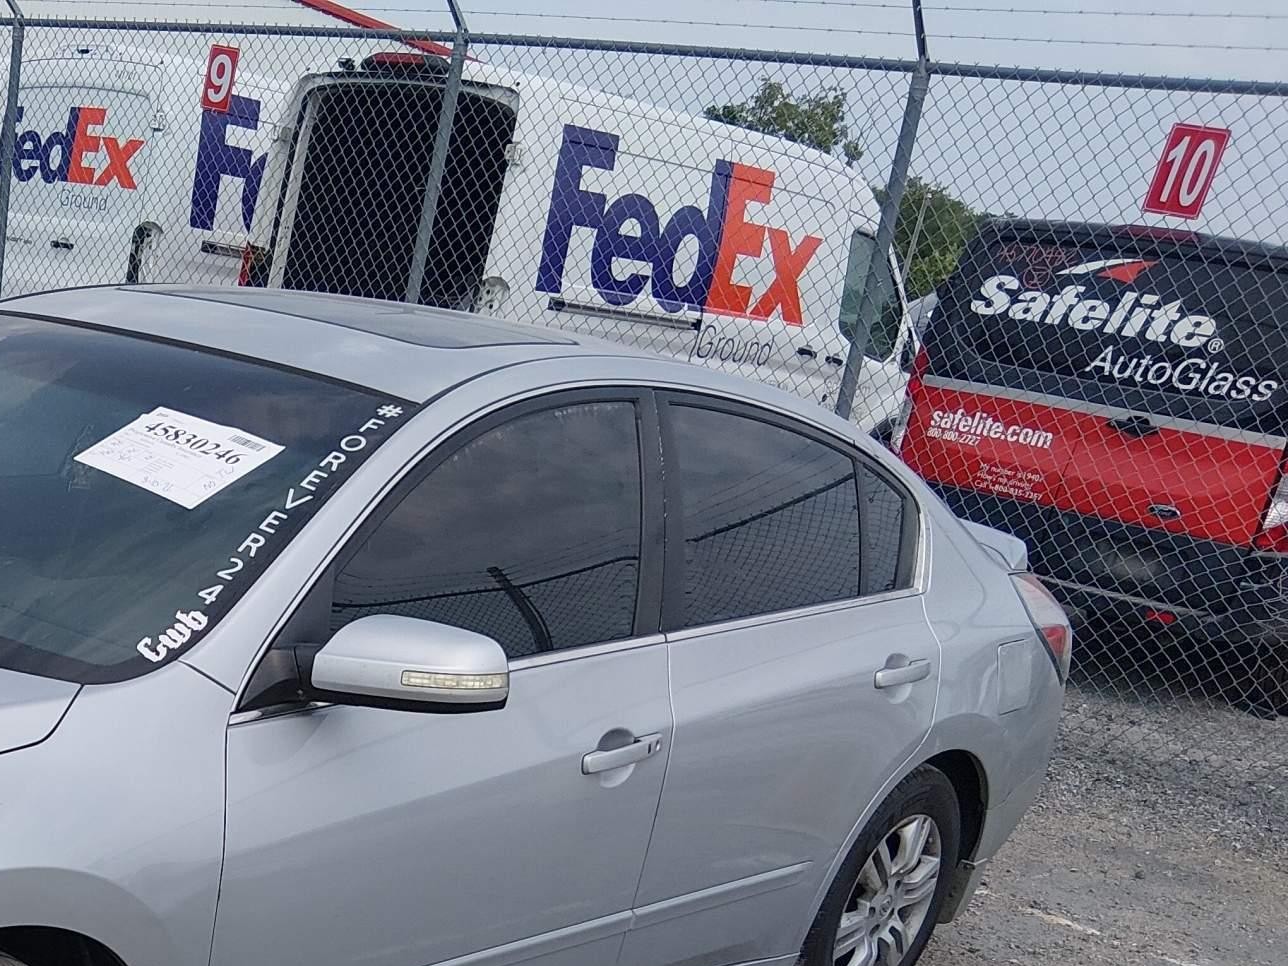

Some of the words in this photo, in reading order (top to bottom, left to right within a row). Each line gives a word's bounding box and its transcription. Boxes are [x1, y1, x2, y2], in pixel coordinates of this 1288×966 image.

[207, 54, 232, 103] 9
[1159, 138, 1215, 208] 10
[61, 188, 109, 212] Ground
[535, 124, 823, 327] FedEx
[697, 325, 774, 367] Ground
[1085, 345, 1279, 402] AutoGlass
[145, 421, 248, 465] 45830246
[930, 408, 1053, 449] safelite.com
